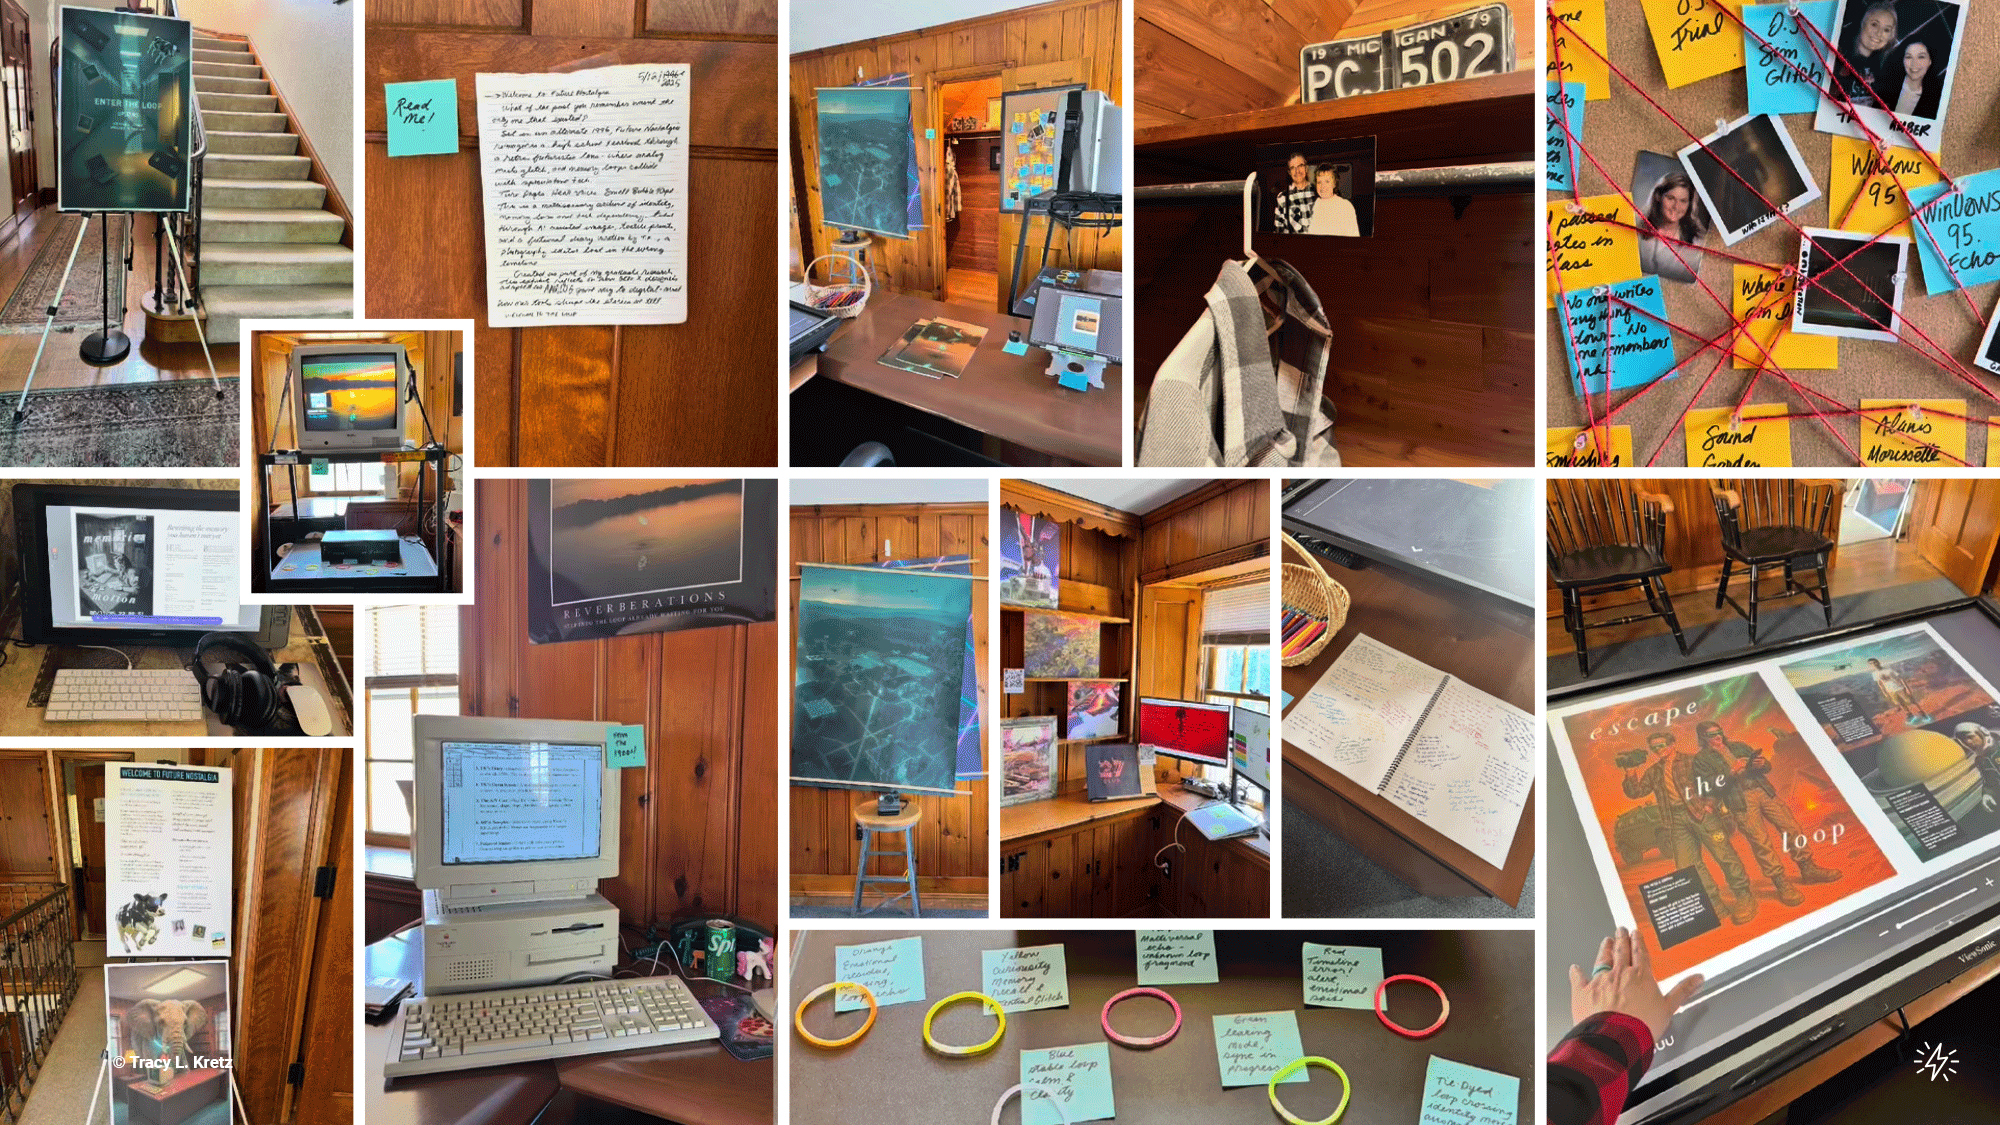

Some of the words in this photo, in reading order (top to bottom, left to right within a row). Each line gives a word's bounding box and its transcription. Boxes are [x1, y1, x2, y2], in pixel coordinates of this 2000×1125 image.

[1311, 48, 1326, 60] 19
[1347, 25, 1446, 56] MICIGAN
[1467, 13, 1491, 29] 79
[1671, 12, 1723, 51] Trial
[1401, 33, 1495, 88] 502
[1766, 63, 1822, 86] Glitch
[95, 97, 121, 107] ENTER
[392, 97, 432, 117] Read
[403, 112, 435, 132] Me!
[1852, 150, 1922, 175] Windows
[1868, 181, 1897, 207] 95
[1556, 208, 1618, 236] passed
[1591, 229, 1613, 246] in
[1627, 322, 1647, 336] No
[1875, 412, 1932, 436] Alanis
[1702, 425, 1756, 451] Sound
[564, 591, 727, 620] REVERBERATIONS
[710, 605, 725, 613] YOU
[1590, 700, 1698, 741] escape
[121, 768, 152, 778] WELCOME
[153, 770, 161, 778] TO
[162, 771, 185, 780] FUTURE
[185, 772, 218, 783] NOSTALGIA
[1684, 773, 1727, 800] the
[1782, 822, 1846, 853] loop
[1323, 947, 1347, 956] Red
[1958, 940, 1997, 964] ViewSonic
[1048, 1049, 1075, 1060] Blue
